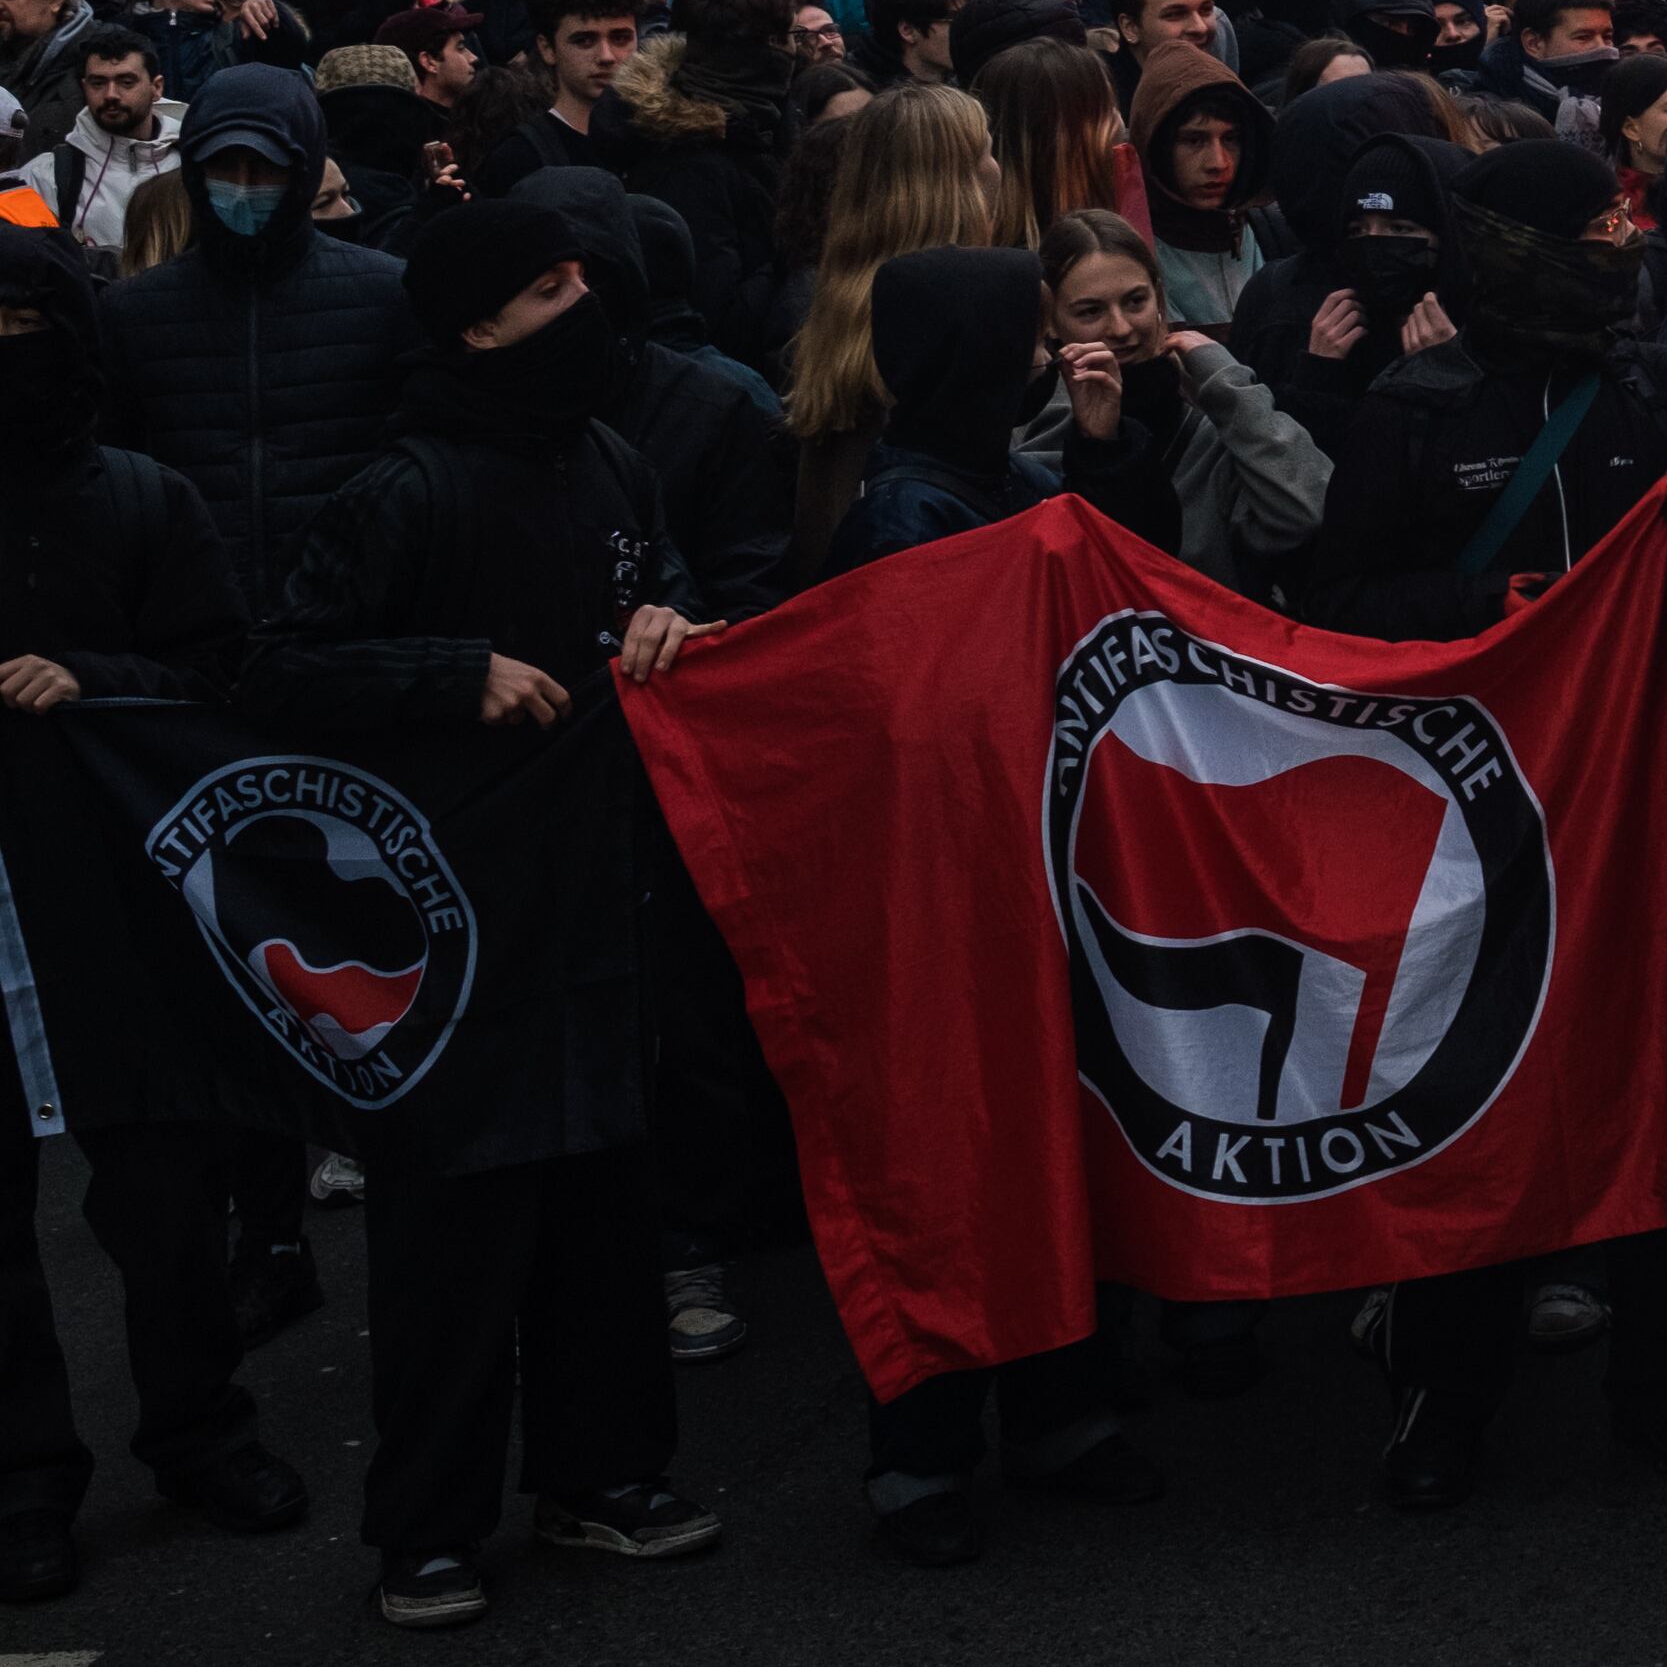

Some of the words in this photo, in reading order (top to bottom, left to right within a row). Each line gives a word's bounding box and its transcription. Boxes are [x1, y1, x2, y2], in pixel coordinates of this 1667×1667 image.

[1056, 625, 1503, 803] ANTIFASCHISTISCHE
[160, 770, 465, 935] NTIFASCHISTISCHE
[266, 1007, 403, 1095] AKTION
[1157, 1110, 1422, 1187] AKTION
